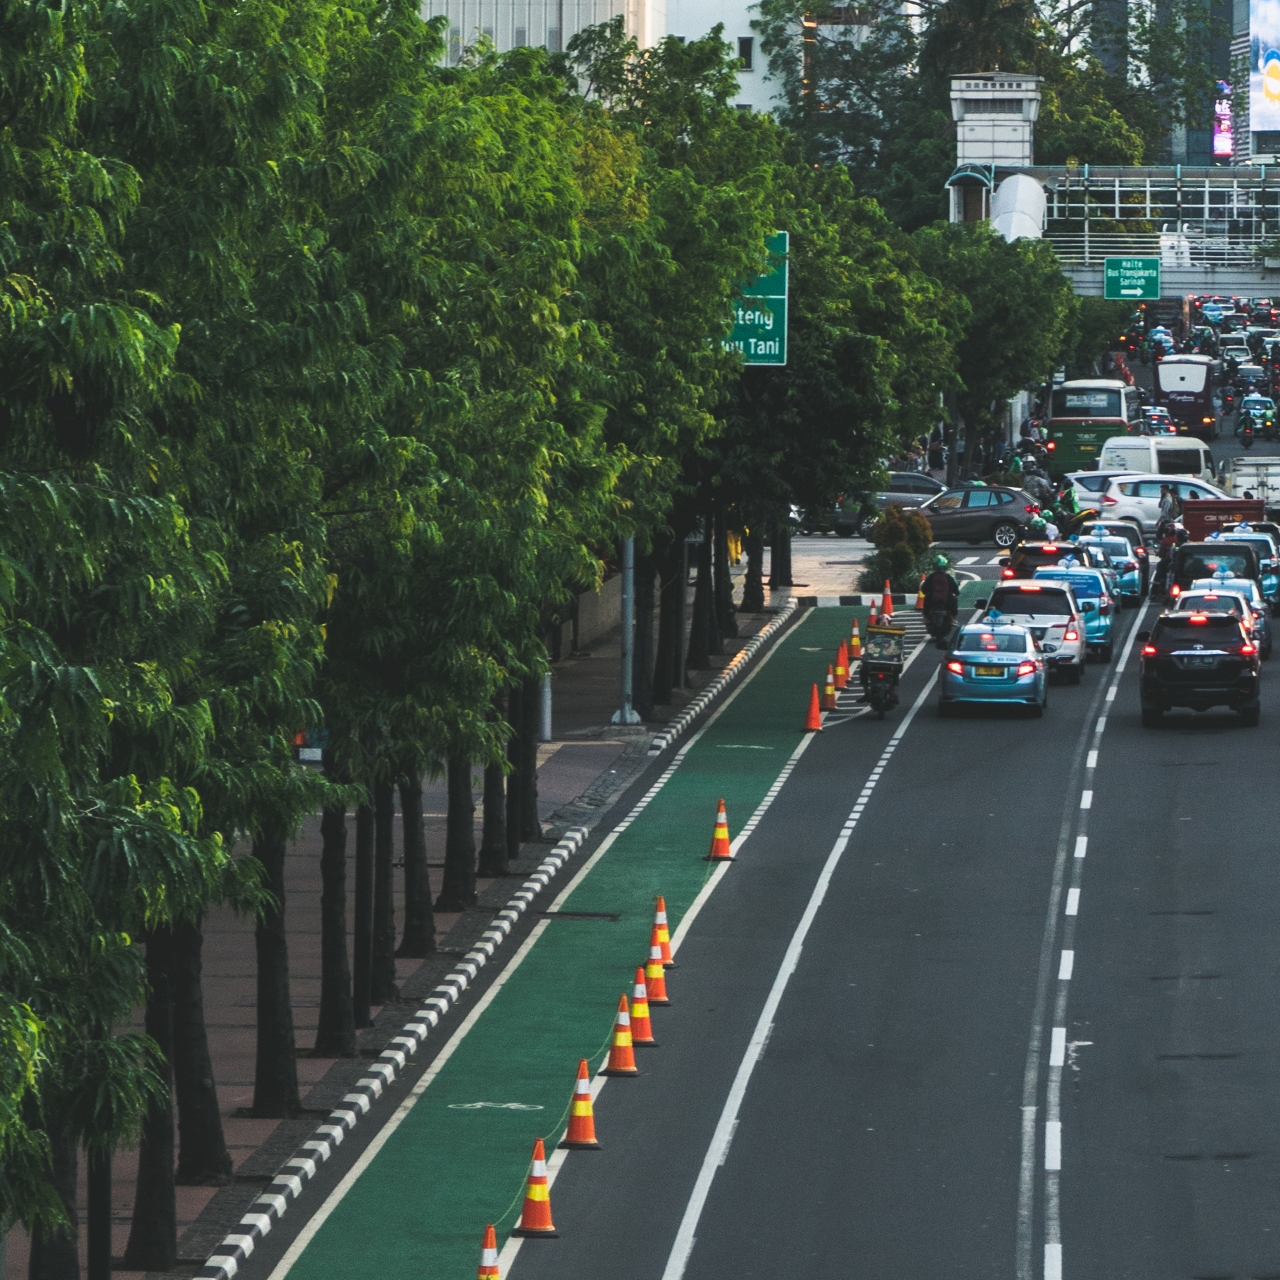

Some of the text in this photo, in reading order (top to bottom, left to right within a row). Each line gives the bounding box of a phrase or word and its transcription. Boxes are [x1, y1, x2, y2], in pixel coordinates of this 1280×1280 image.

[1121, 260, 1143, 268] Halte
[1107, 268, 1157, 278] Bus Transjakarta
[1120, 277, 1146, 286] Sarinah
[748, 337, 780, 355] Tani
